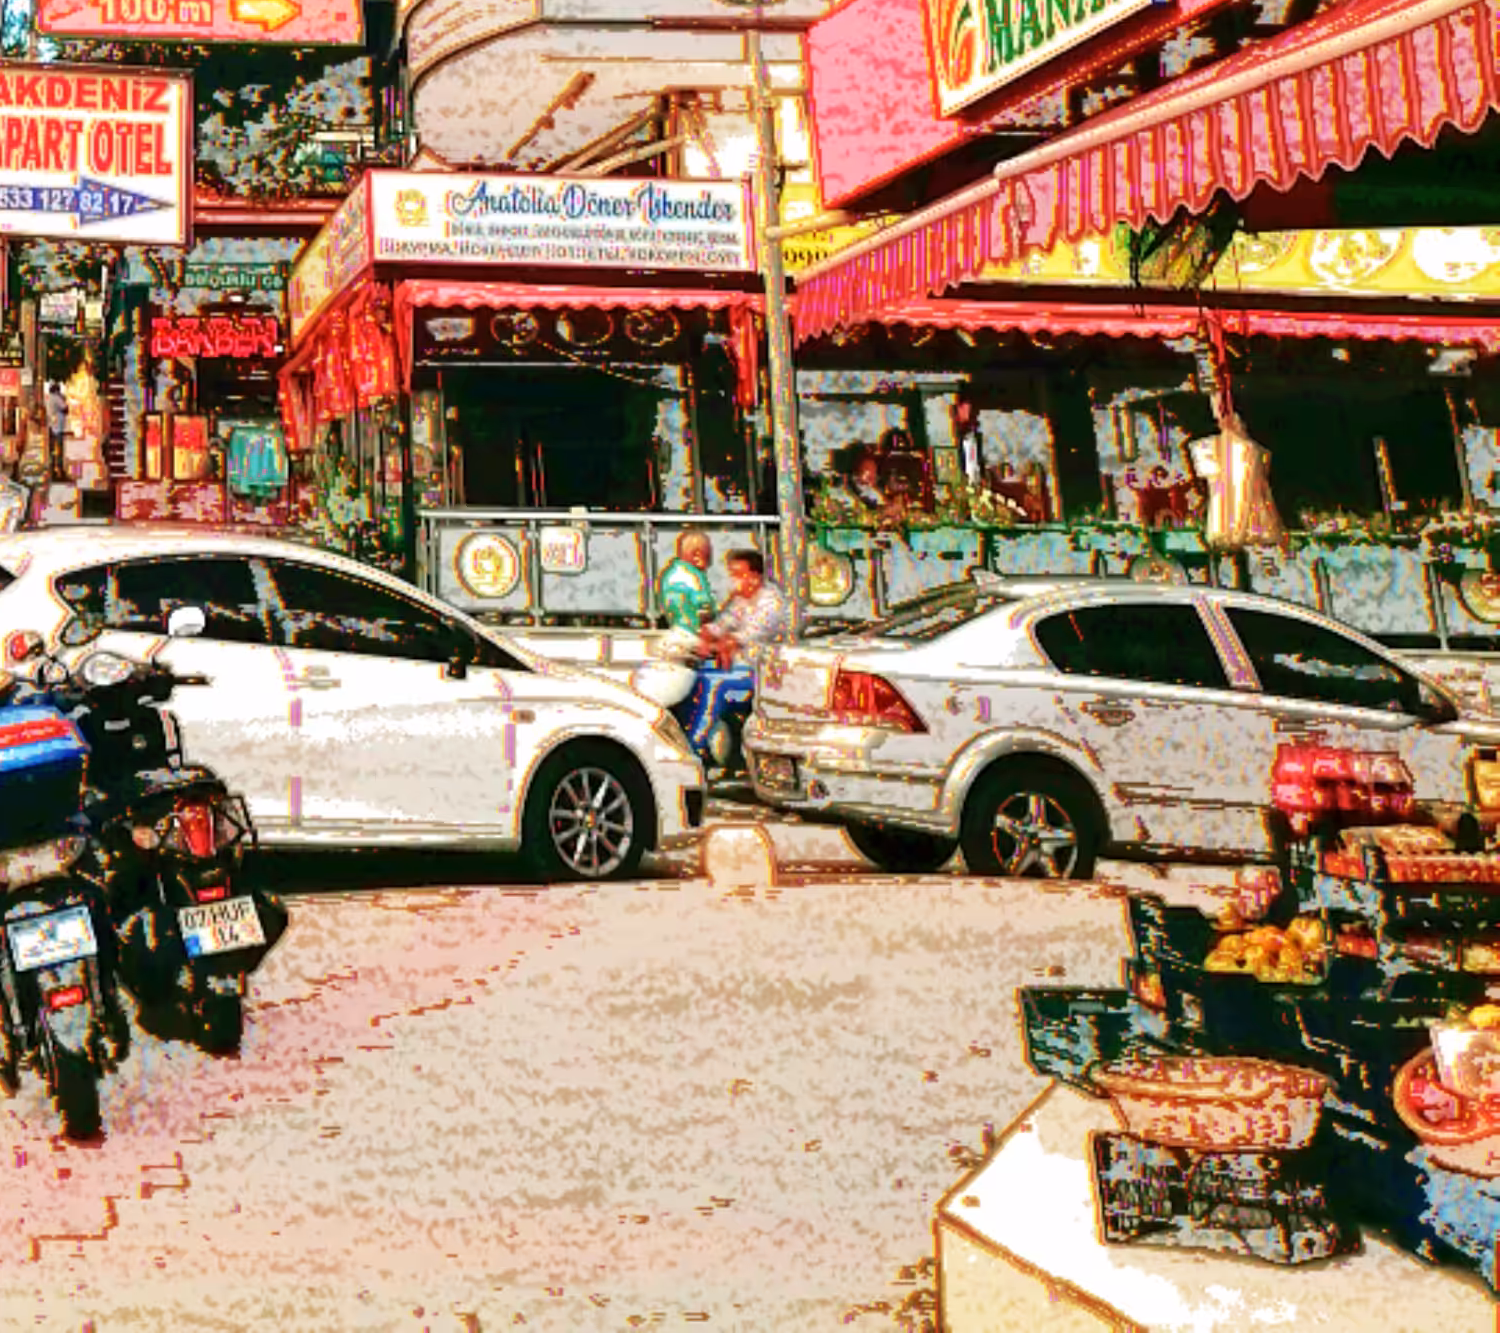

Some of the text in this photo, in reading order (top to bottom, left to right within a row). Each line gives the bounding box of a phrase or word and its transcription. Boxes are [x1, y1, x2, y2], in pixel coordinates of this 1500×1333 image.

[90, 119, 173, 176] OTEL
[41, 190, 73, 212] 127
[79, 192, 103, 213] 82
[110, 193, 133, 214] 17
[452, 180, 560, 215] Anatolia
[563, 183, 632, 219] Döner
